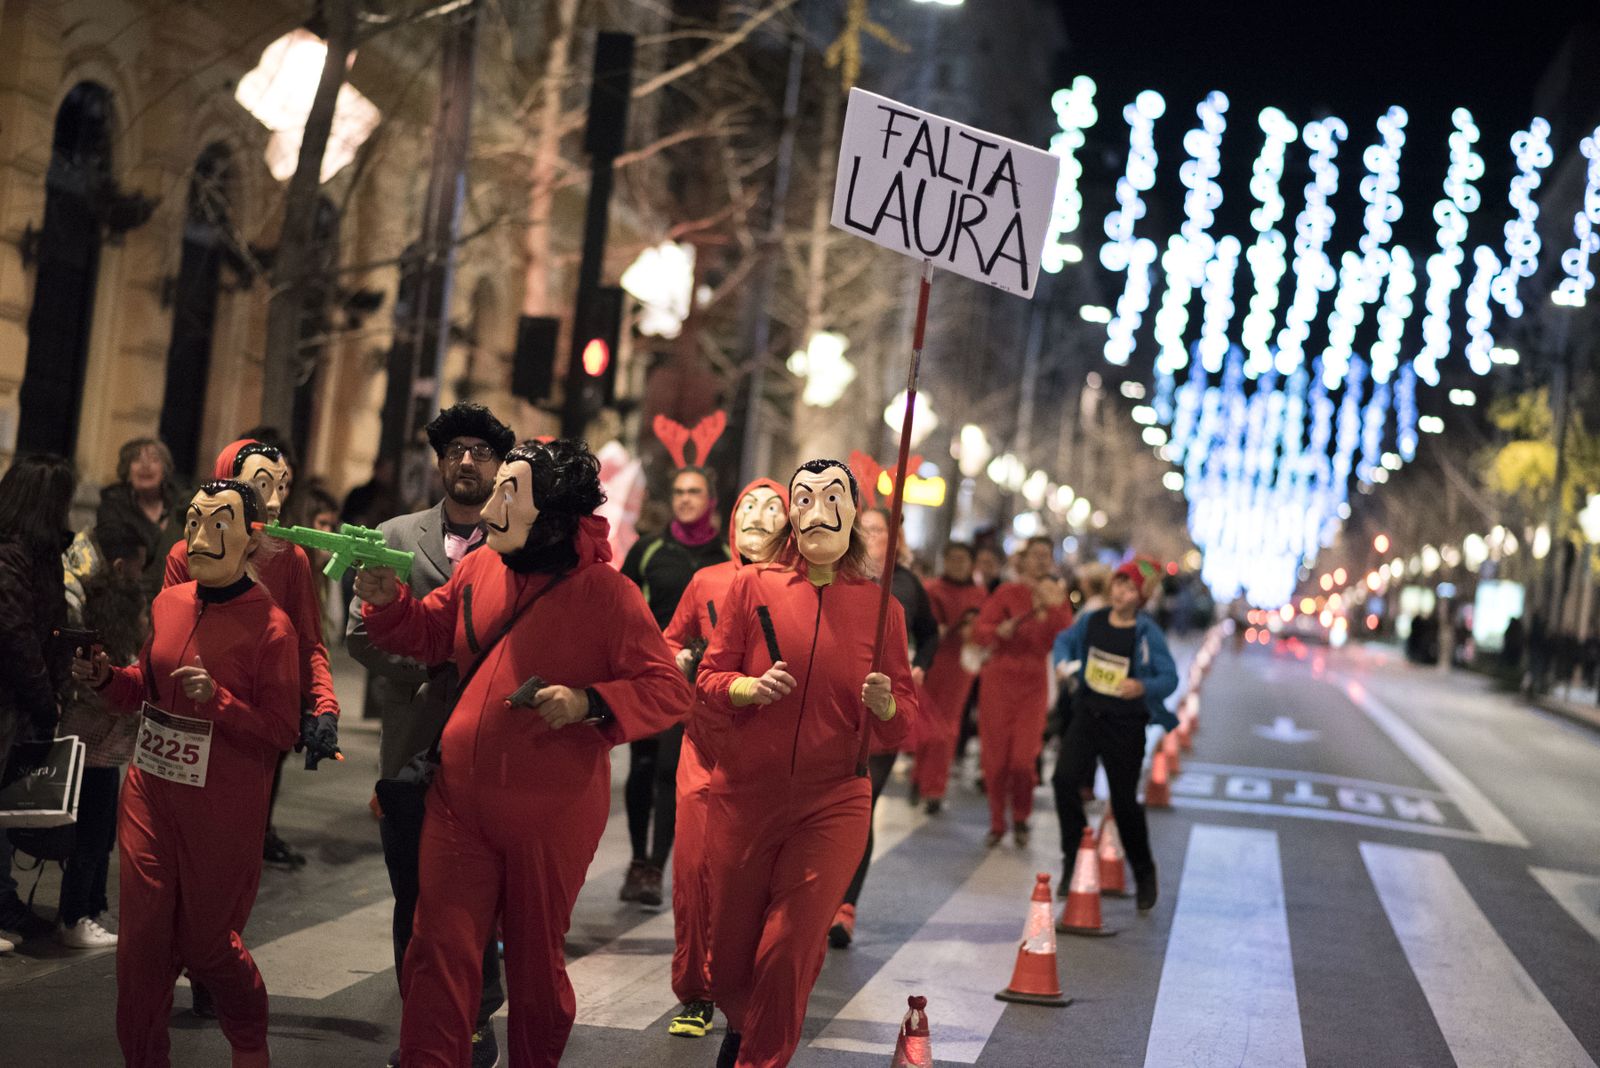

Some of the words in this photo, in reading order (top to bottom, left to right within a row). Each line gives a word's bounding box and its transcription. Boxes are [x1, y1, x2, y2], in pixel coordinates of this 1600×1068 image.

[877, 105, 1022, 209] FALTA
[844, 156, 1030, 291] LAURA
[140, 729, 200, 765] 2225
